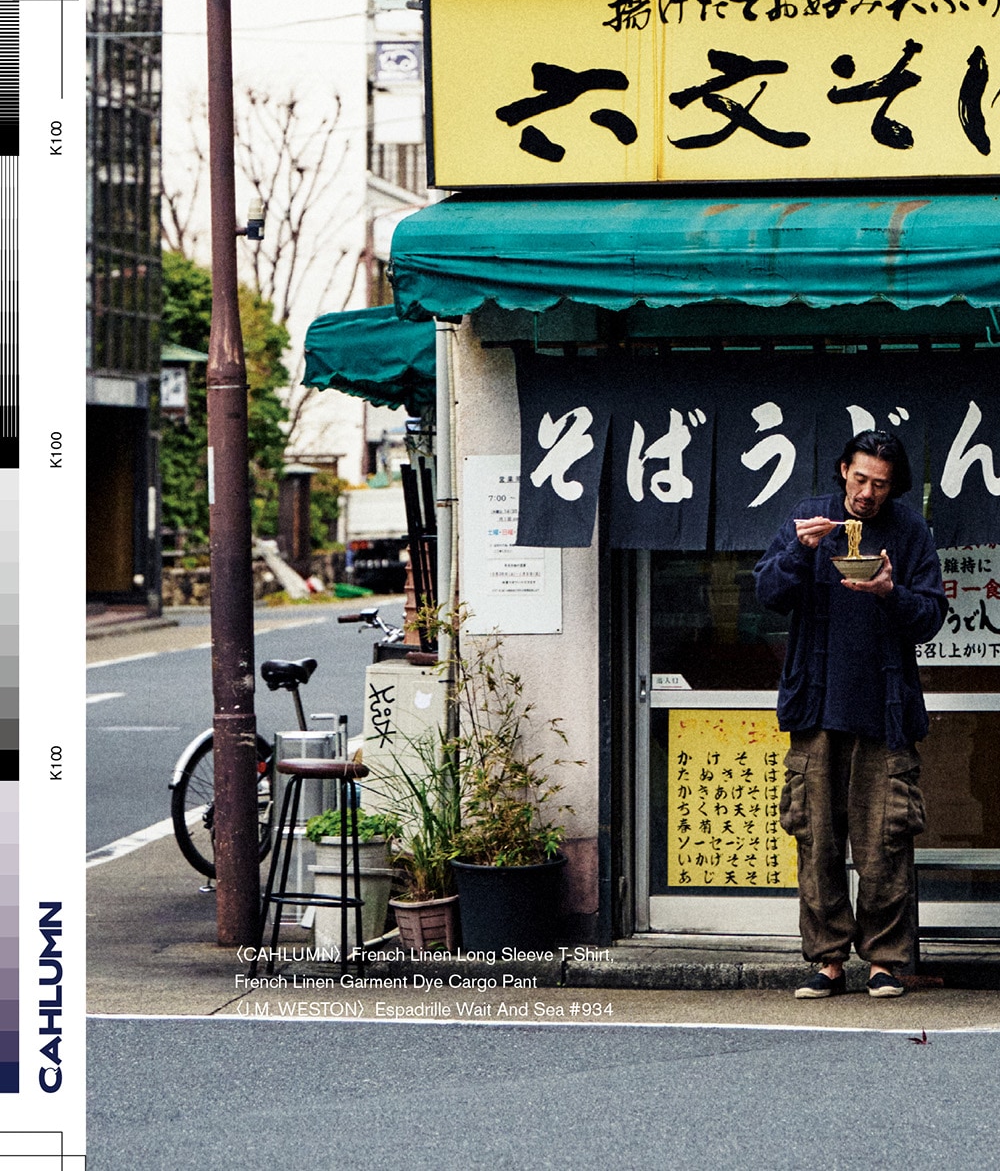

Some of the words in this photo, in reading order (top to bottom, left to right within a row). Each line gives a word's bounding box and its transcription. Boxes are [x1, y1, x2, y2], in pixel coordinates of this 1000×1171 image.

[939, 557, 992, 574] 維持に
[678, 751, 778, 766] かけそば
[678, 768, 779, 782] たぬきそば
[678, 785, 779, 800] かきあげそば
[677, 802, 778, 817] ちくわ天そば
[677, 820, 779, 834] 春菊天そば
[678, 836, 779, 852] ソーセージそば
[678, 853, 779, 868] いかげそそば
[679, 870, 780, 885] あじ天そば
